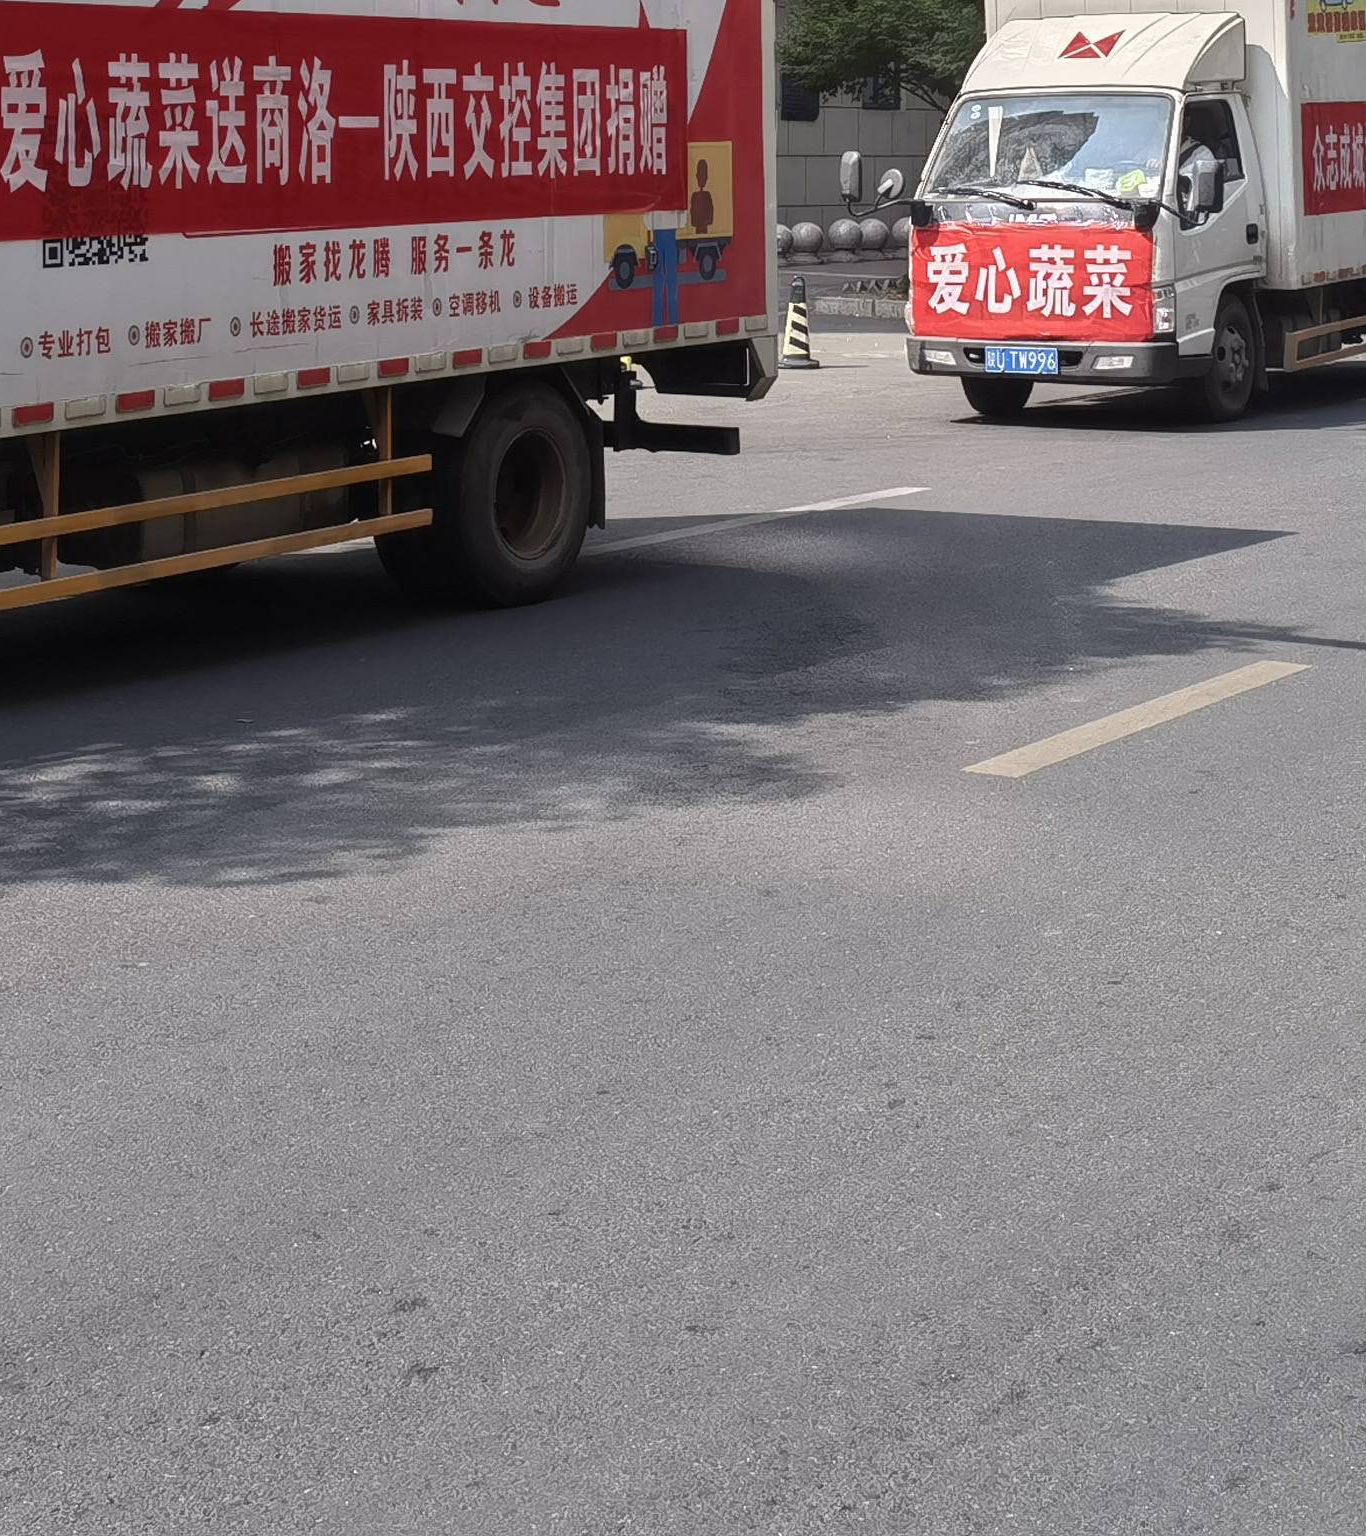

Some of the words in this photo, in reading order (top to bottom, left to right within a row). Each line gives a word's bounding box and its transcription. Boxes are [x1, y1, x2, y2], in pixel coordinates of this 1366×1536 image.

[272, 236, 392, 287] 搬家找龙腾
[410, 228, 516, 276] 服务一条龙
[926, 243, 1133, 319] 爱心蔬菜
[37, 325, 112, 360] 专业打包
[144, 317, 212, 349] 搬家搬厂
[248, 304, 343, 338] 长途搬家货运
[366, 298, 423, 326] 家具拆装
[448, 289, 501, 318] 空调移机
[528, 283, 579, 310] 设备搬运
